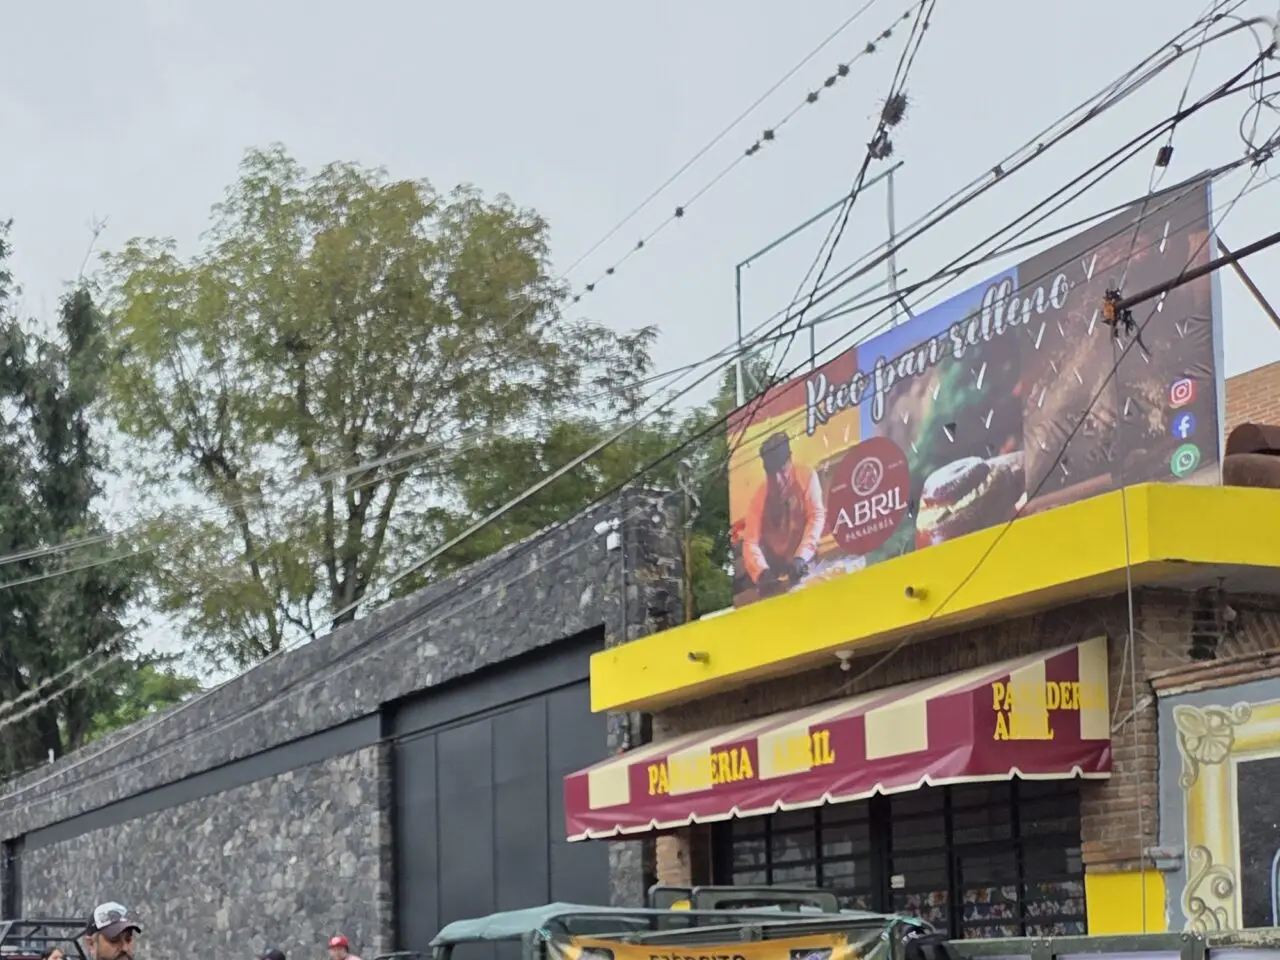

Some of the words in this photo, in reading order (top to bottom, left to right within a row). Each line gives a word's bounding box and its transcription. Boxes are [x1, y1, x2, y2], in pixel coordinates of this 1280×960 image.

[806, 372, 868, 436] Rico
[872, 338, 944, 422] pan
[832, 486, 908, 534] ABRIL
[992, 681, 1107, 711] PADER
[648, 746, 754, 795] PAERIA
[772, 730, 835, 774] AIL
